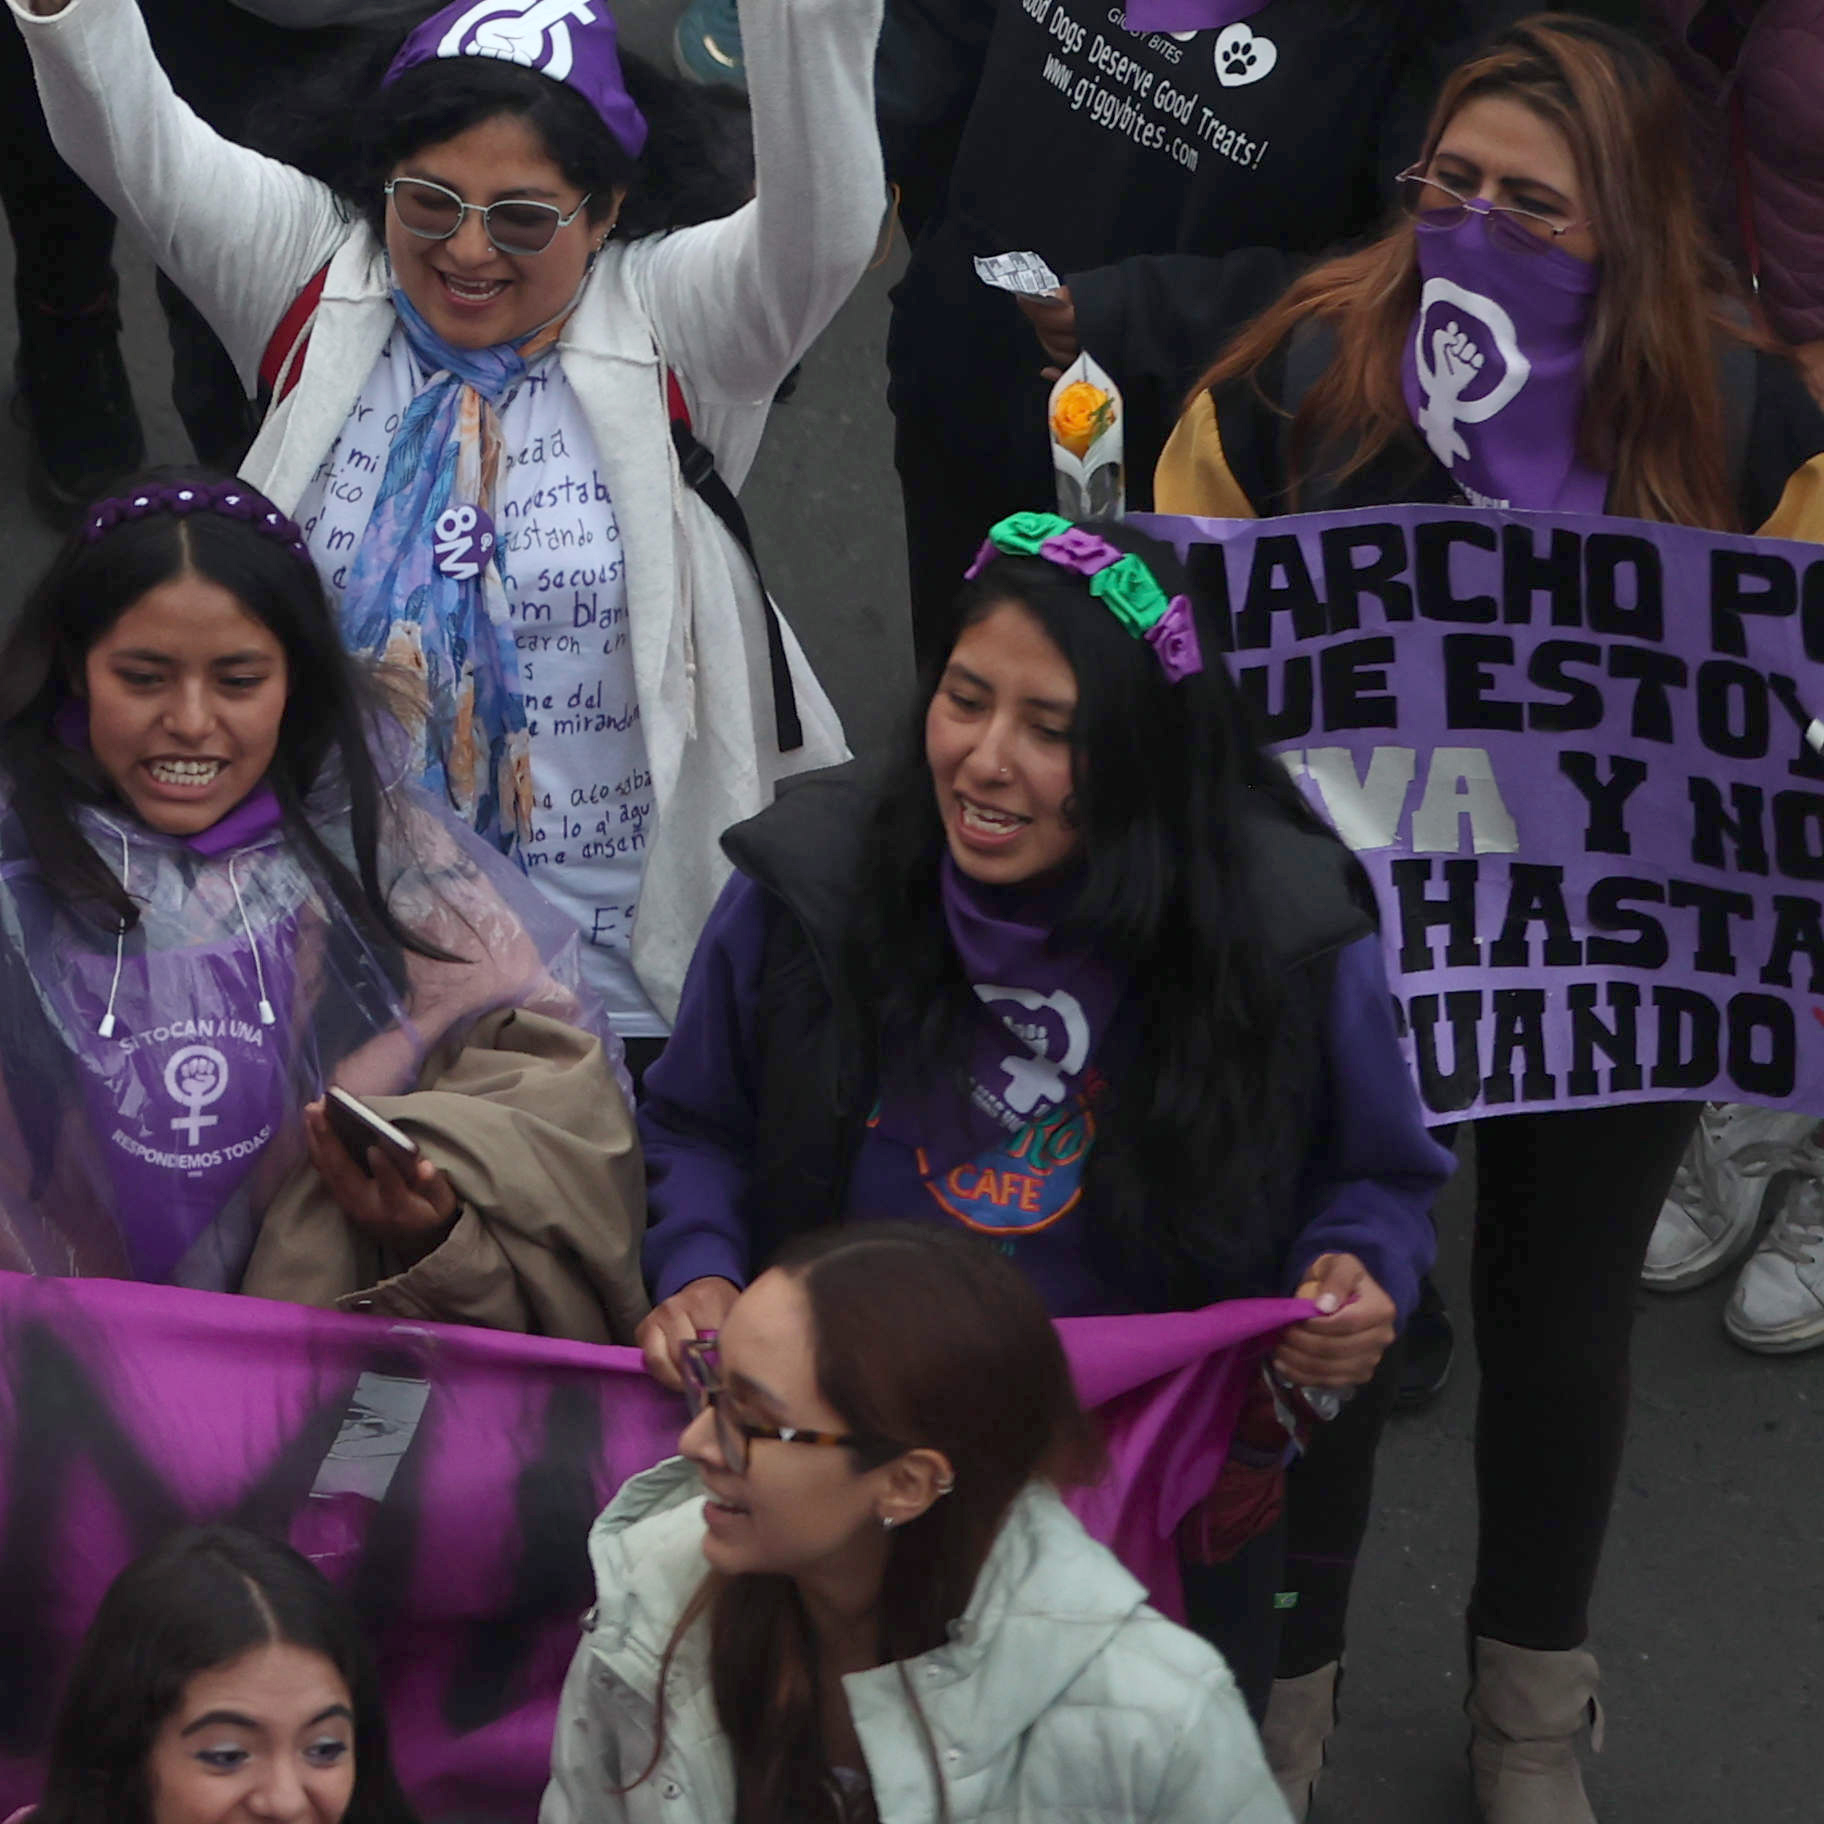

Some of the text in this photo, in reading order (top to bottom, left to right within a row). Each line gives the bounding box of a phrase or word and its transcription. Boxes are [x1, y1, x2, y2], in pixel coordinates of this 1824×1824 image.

[1048, 5, 1088, 55] Dogs
[1087, 34, 1155, 99] Deserve
[1153, 79, 1199, 126] Good
[1197, 107, 1269, 171] Treats!
[1148, 35, 1184, 65] BITES
[1042, 52, 1200, 173] www.giggybites.com
[434, 504, 481, 582] 8M
[1237, 635, 1399, 744] UE
[1559, 750, 1648, 856] Y
[1687, 775, 1824, 883] NO
[1390, 857, 1824, 994] HASTA
[139, 1019, 214, 1046] TOCAN
[229, 1019, 264, 1048] UNA
[1393, 979, 1796, 1114] UANDO
[110, 1127, 224, 1170] RESPONDEMOS
